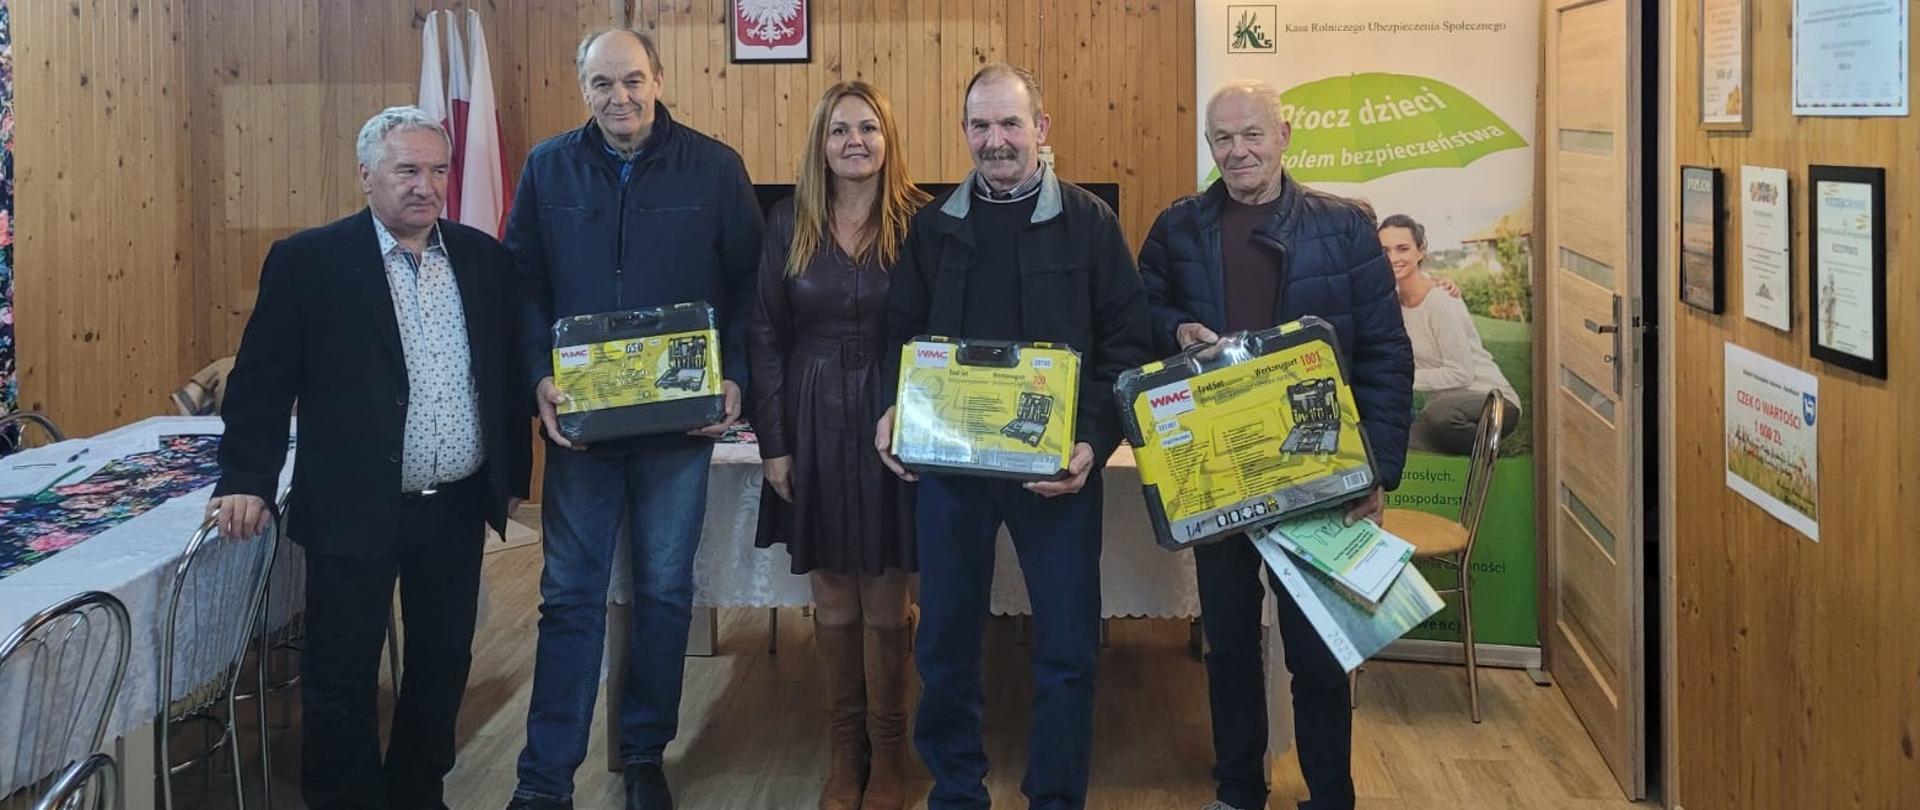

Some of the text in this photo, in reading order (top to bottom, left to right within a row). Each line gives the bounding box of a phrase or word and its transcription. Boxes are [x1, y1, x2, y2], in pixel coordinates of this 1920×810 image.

[1285, 20, 1506, 34] Kasa Rolniczego Ubezpieczenia Społecznego
[1358, 85, 1447, 127] dzieci
[1341, 121, 1505, 168] bezpieczeństwa
[917, 349, 948, 360] WMC
[1300, 351, 1321, 369] 1001
[1150, 388, 1191, 409] WMC
[1762, 400, 1801, 430] WARTOŚCI
[1472, 561, 1506, 573] ności
